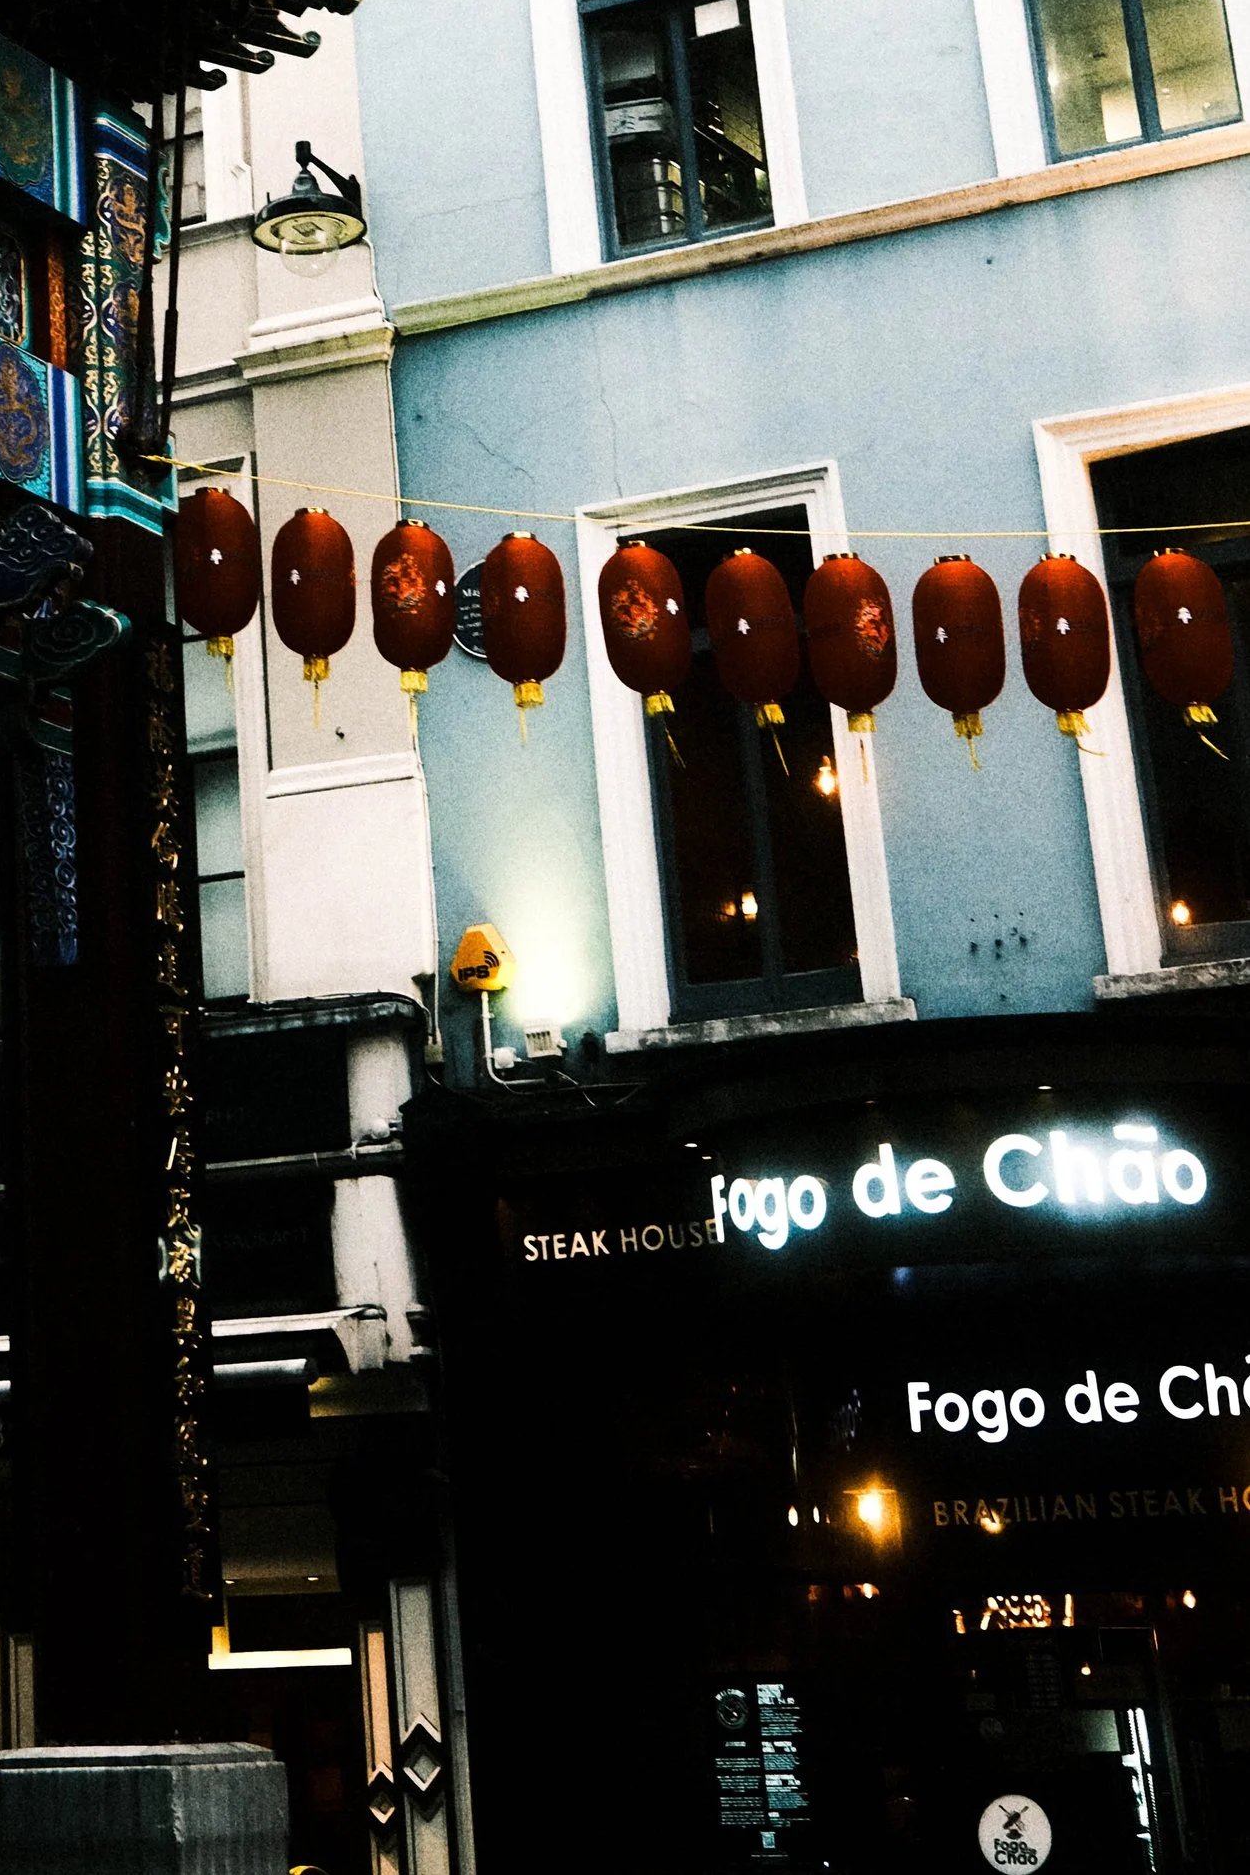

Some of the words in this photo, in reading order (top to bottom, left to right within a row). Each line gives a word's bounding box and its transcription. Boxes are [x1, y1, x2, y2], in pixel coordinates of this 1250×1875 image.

[710, 1173, 828, 1251] Fogo
[851, 1142, 957, 1219] de
[983, 1123, 1208, 1208] Chão
[523, 1229, 611, 1262] STEAK
[619, 1218, 717, 1254] HOUSE
[907, 1380, 1046, 1443] Fogo
[1064, 1368, 1139, 1425] de
[1158, 1352, 1250, 1420] Ch
[931, 1491, 1098, 1528] BRAZILIAN
[1108, 1486, 1208, 1521] STEAK
[994, 1838, 1027, 1854] Fogo
